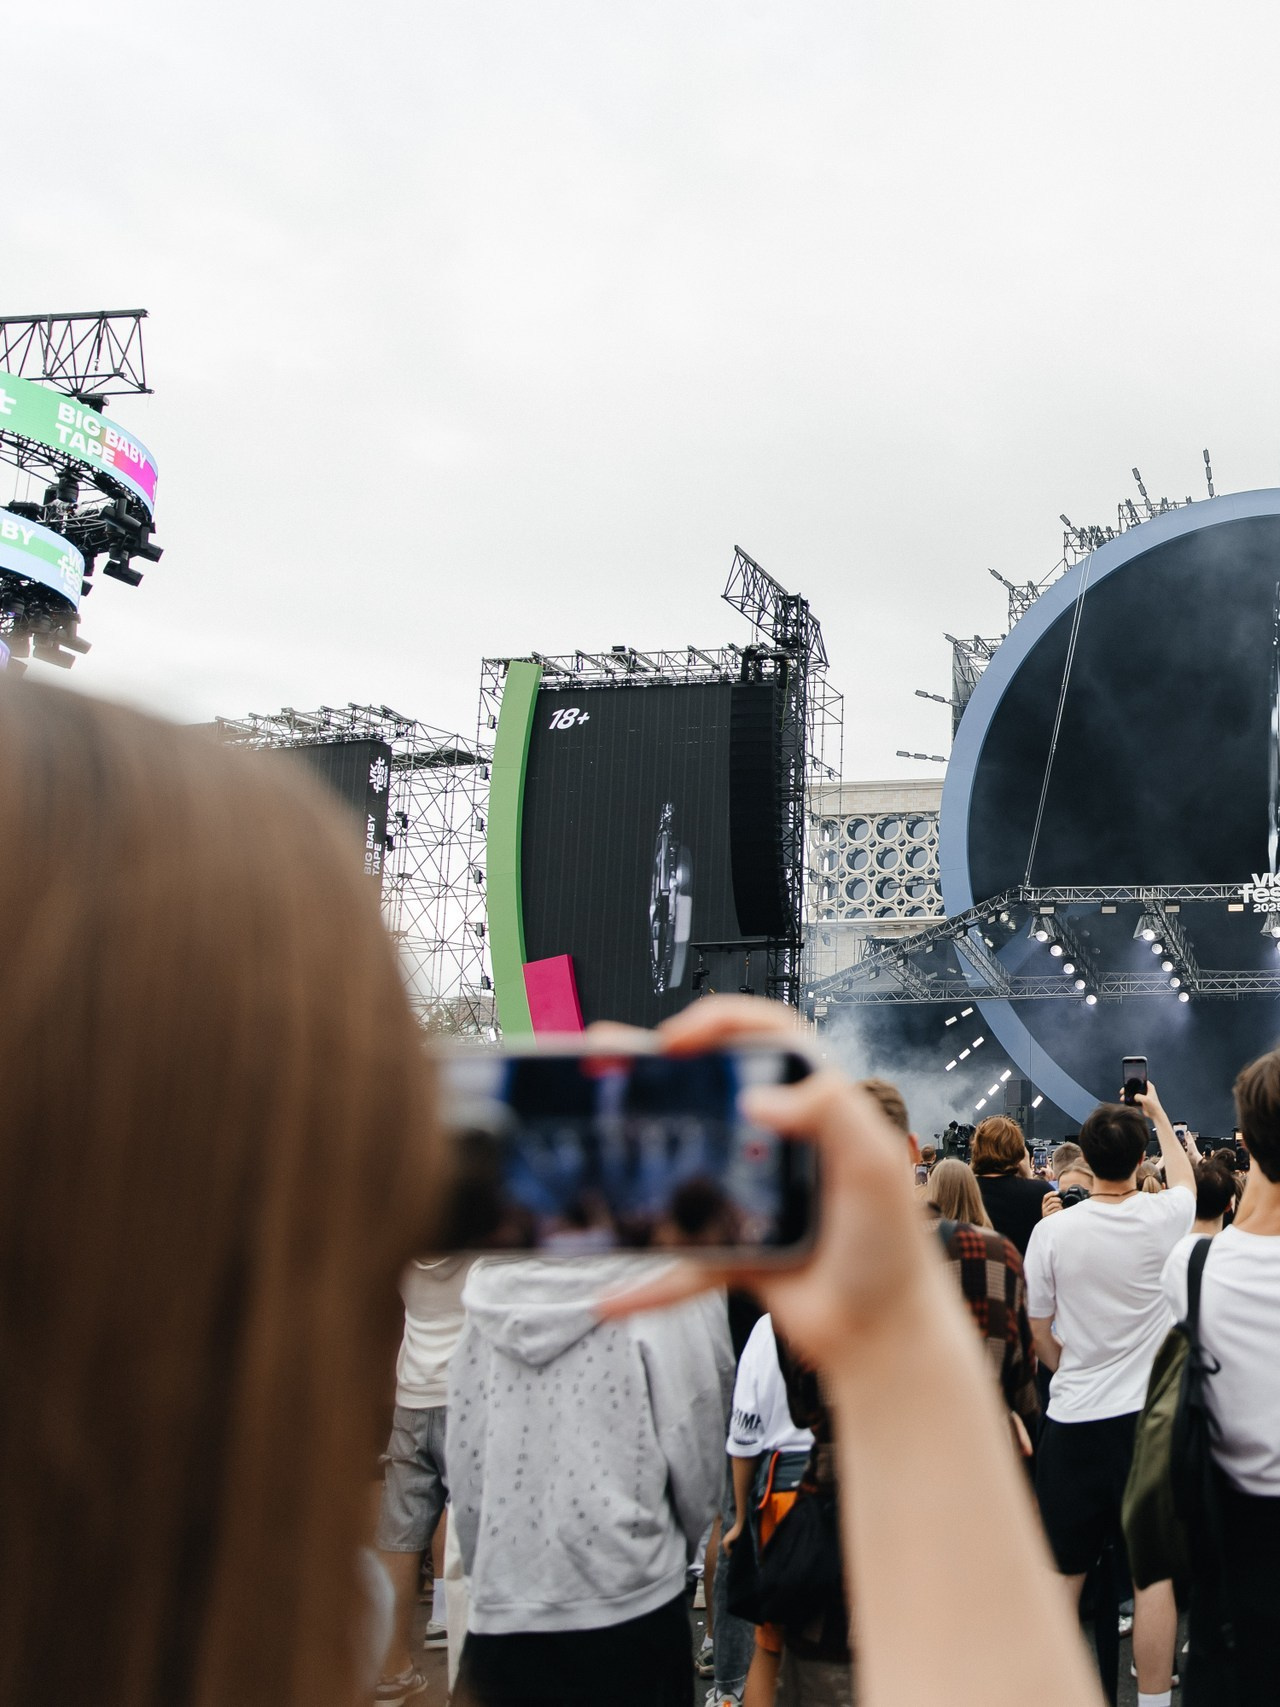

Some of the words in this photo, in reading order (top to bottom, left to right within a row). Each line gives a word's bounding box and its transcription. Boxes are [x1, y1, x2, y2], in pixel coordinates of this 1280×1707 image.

[55, 422, 115, 468] TAPE
[58, 402, 100, 437] BIG
[105, 426, 147, 469] BABY
[549, 707, 590, 730] 18+
[369, 763, 378, 784] VK
[373, 756, 386, 794] fest
[366, 813, 376, 849] BABY
[364, 852, 373, 875] BIG
[372, 842, 382, 877] TAPE
